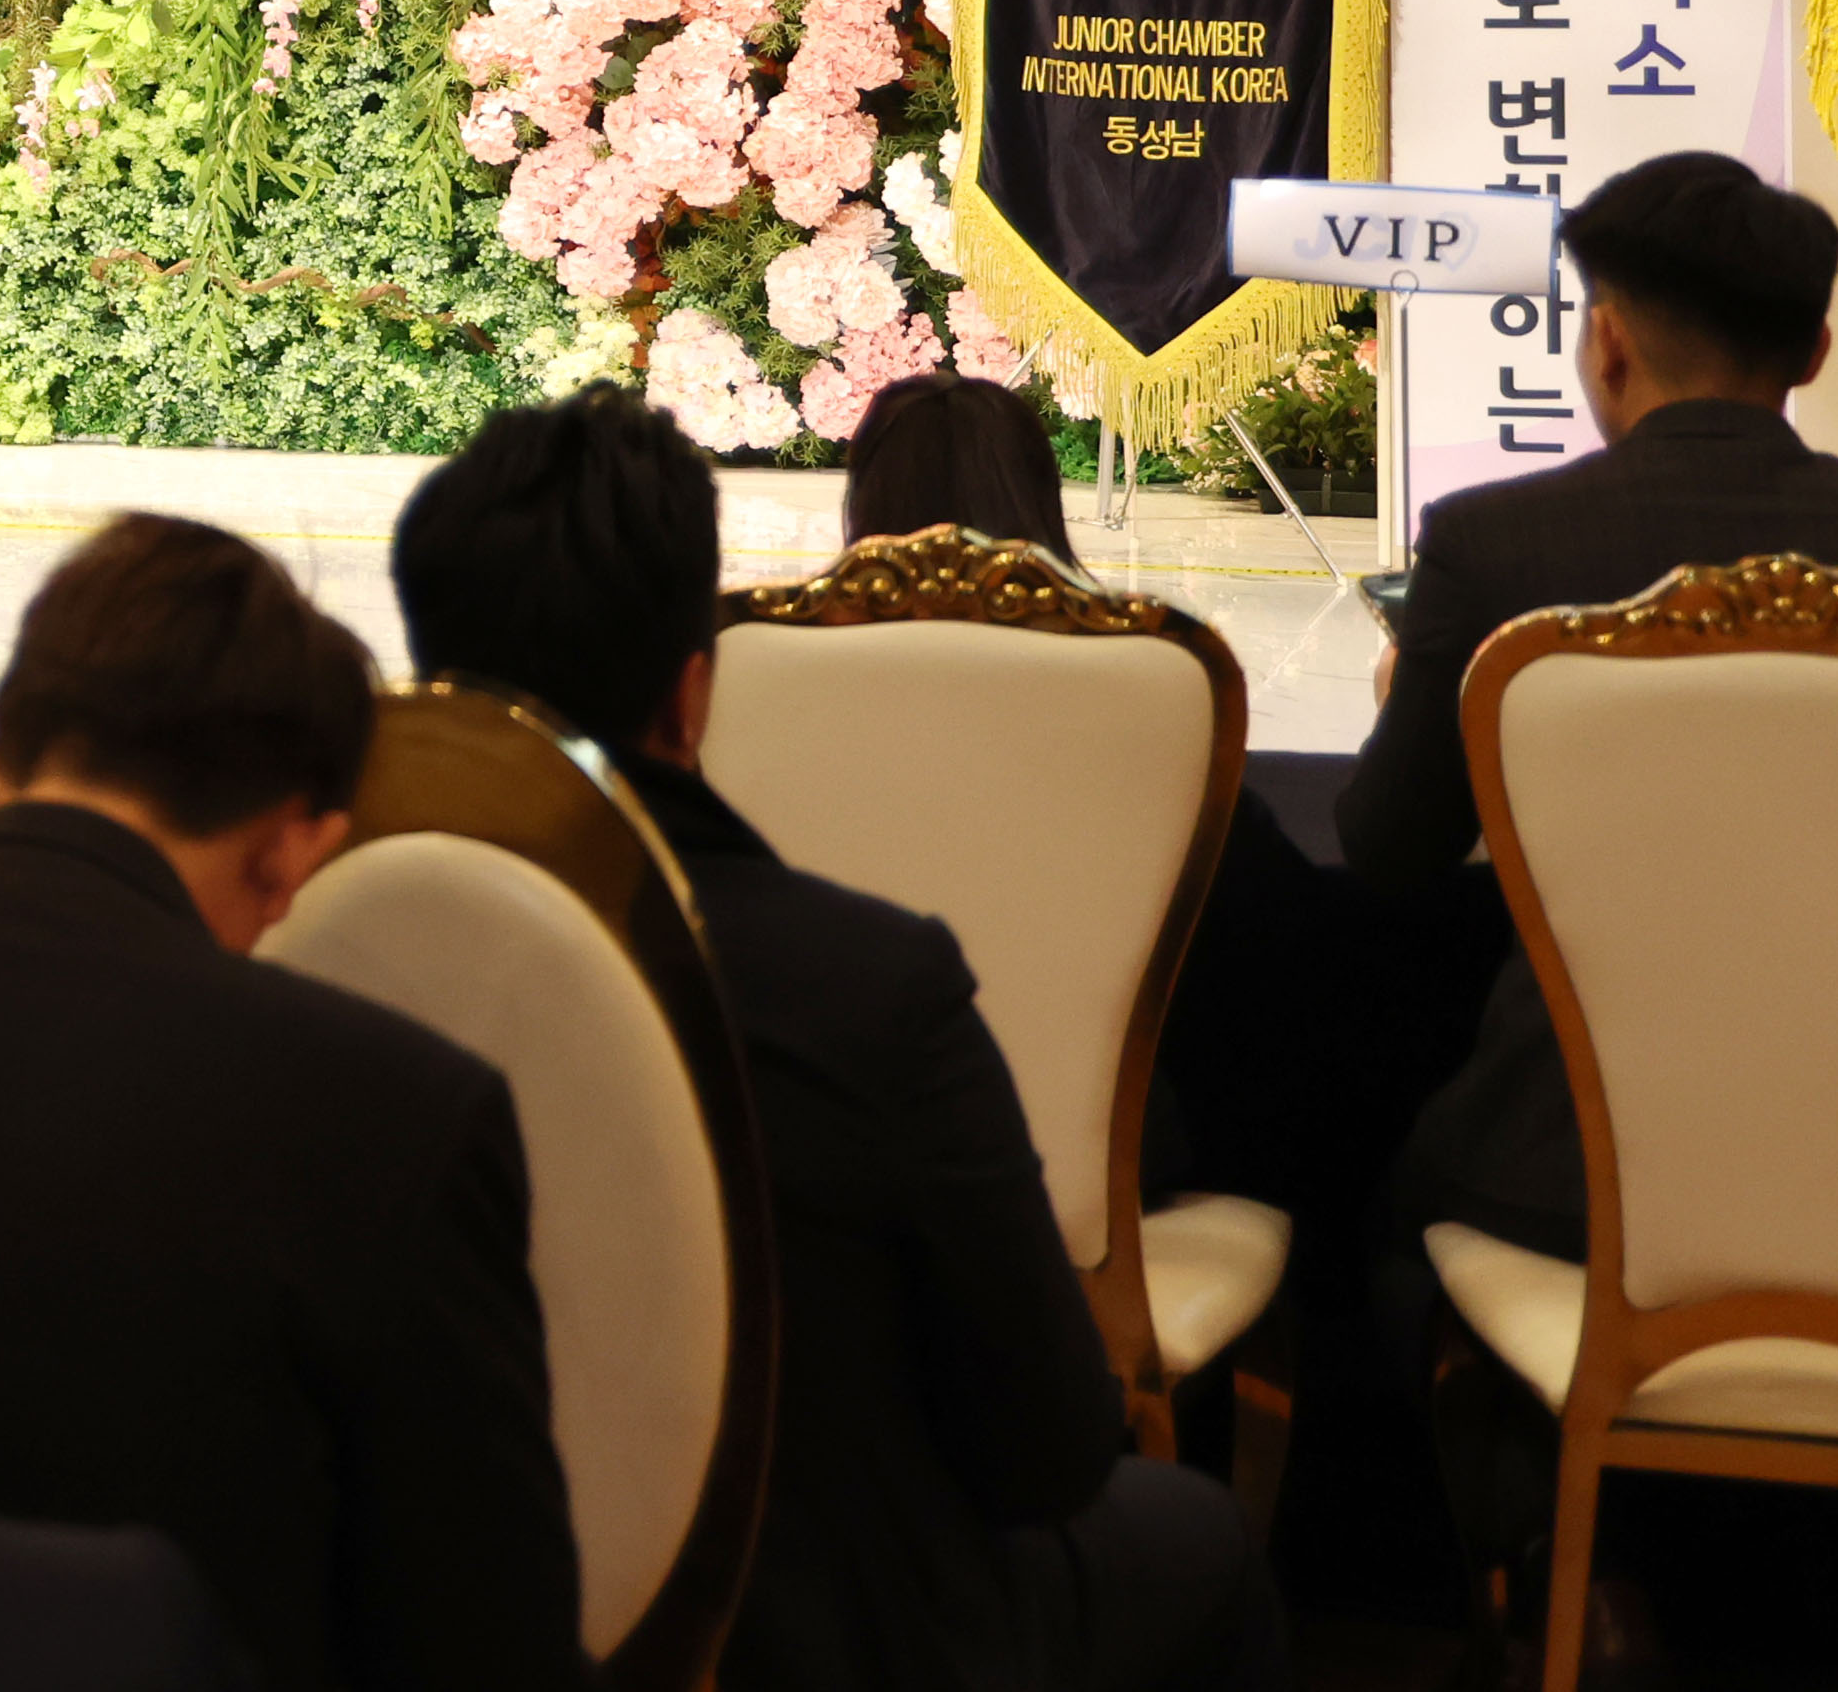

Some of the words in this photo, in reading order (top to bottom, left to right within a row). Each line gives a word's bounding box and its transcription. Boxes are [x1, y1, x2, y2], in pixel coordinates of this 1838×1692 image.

[1053, 15, 1135, 55] JUNIOR
[1139, 19, 1266, 58] CHAMBER
[1021, 55, 1206, 104] INTERNATIONAL
[1211, 66, 1289, 104] KOREA
[1102, 116, 1205, 160] 동성남
[1325, 215, 1461, 262] VIP
[1486, 77, 1574, 453] 변하는
